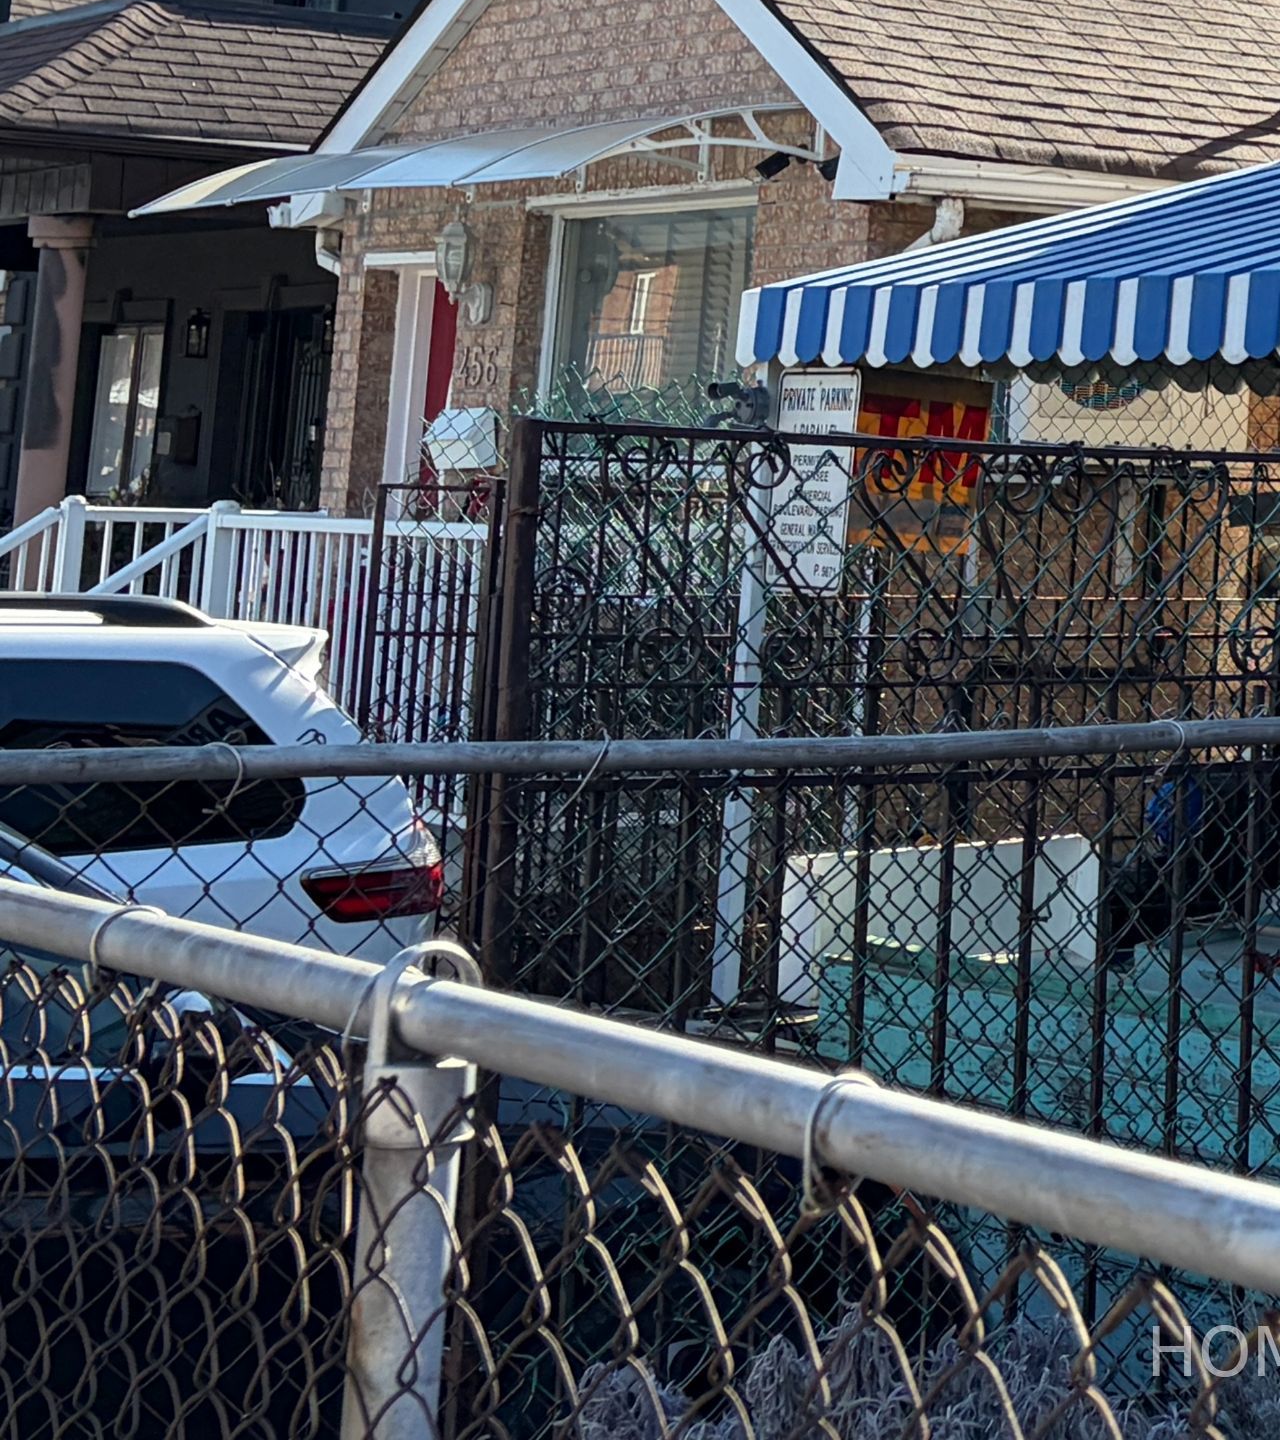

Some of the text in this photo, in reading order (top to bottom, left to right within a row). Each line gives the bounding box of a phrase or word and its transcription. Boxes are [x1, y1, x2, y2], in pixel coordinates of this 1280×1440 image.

[457, 346, 499, 387] 456
[782, 388, 854, 411] PRIVATE PARKING
